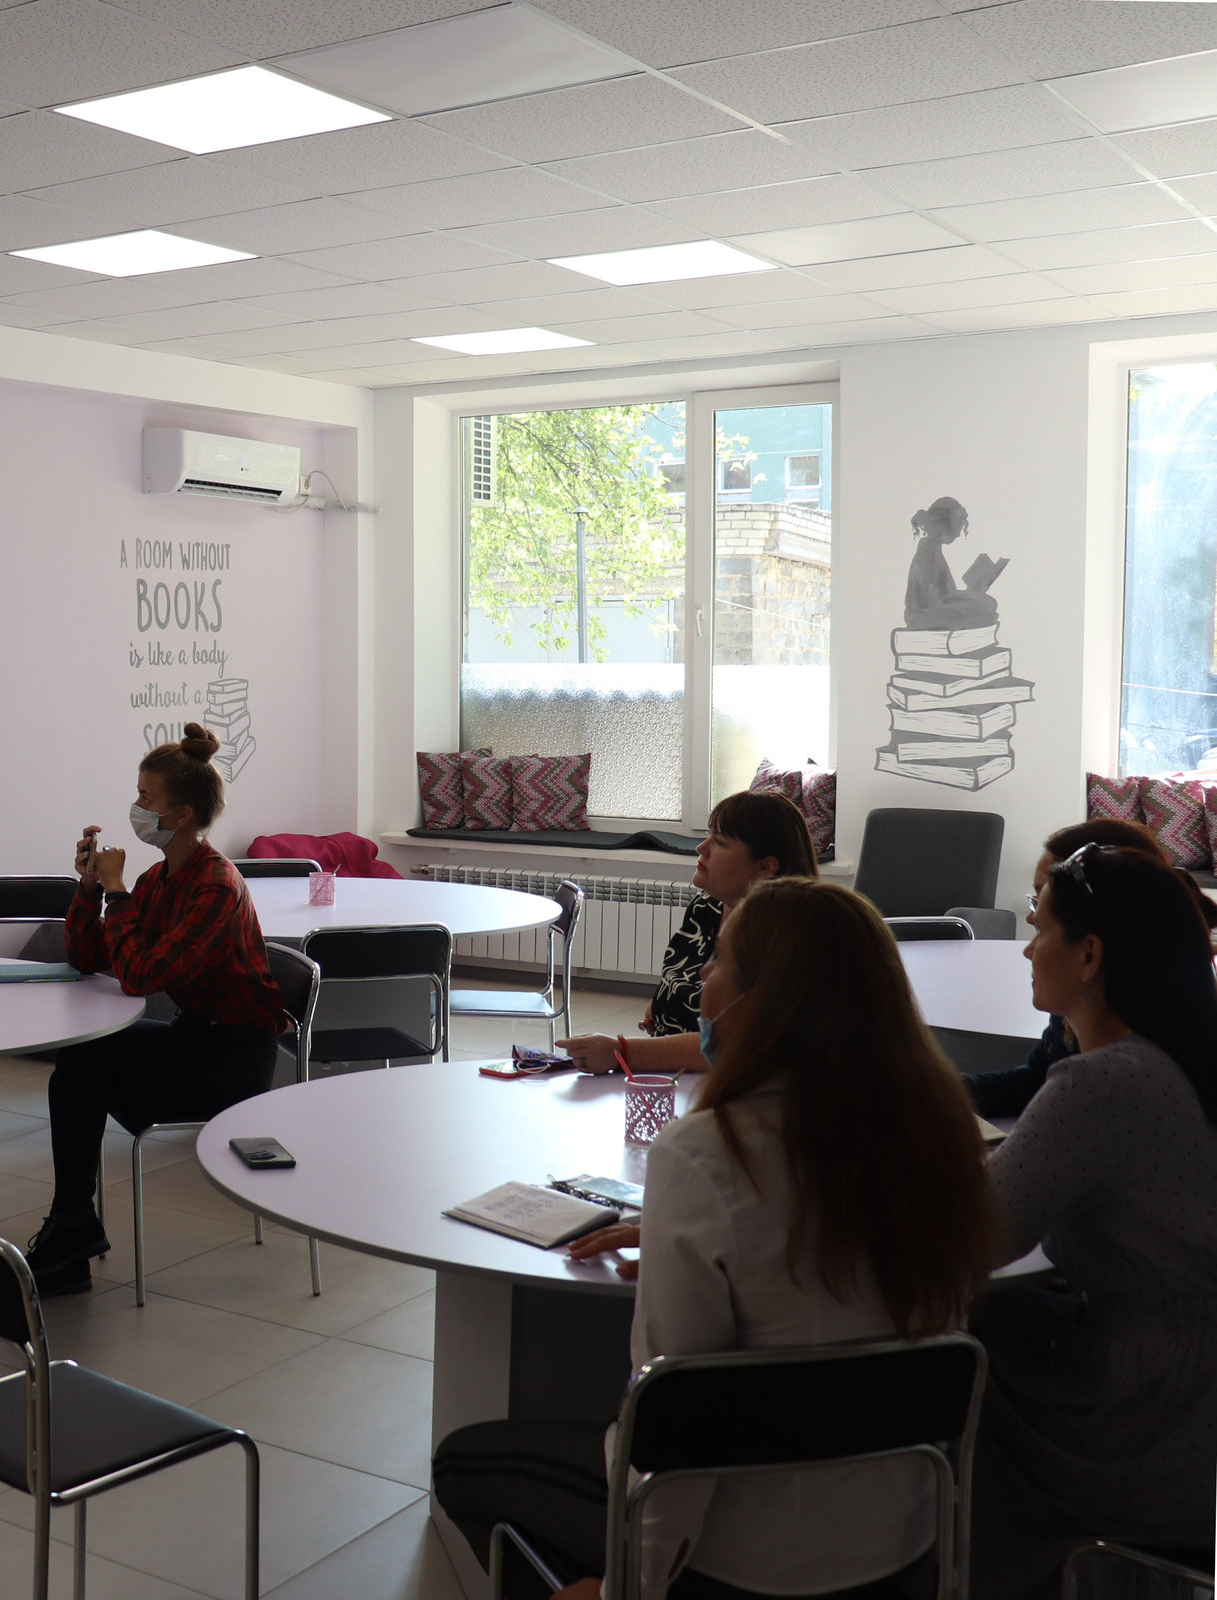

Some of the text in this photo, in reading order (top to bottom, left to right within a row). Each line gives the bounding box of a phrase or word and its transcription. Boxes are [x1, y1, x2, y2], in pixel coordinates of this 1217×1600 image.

[120, 538, 230, 571] A ROOM WITHOUT
[136, 578, 222, 632] BOOKS
[129, 640, 228, 678] is like a body
[130, 681, 204, 708] without a
